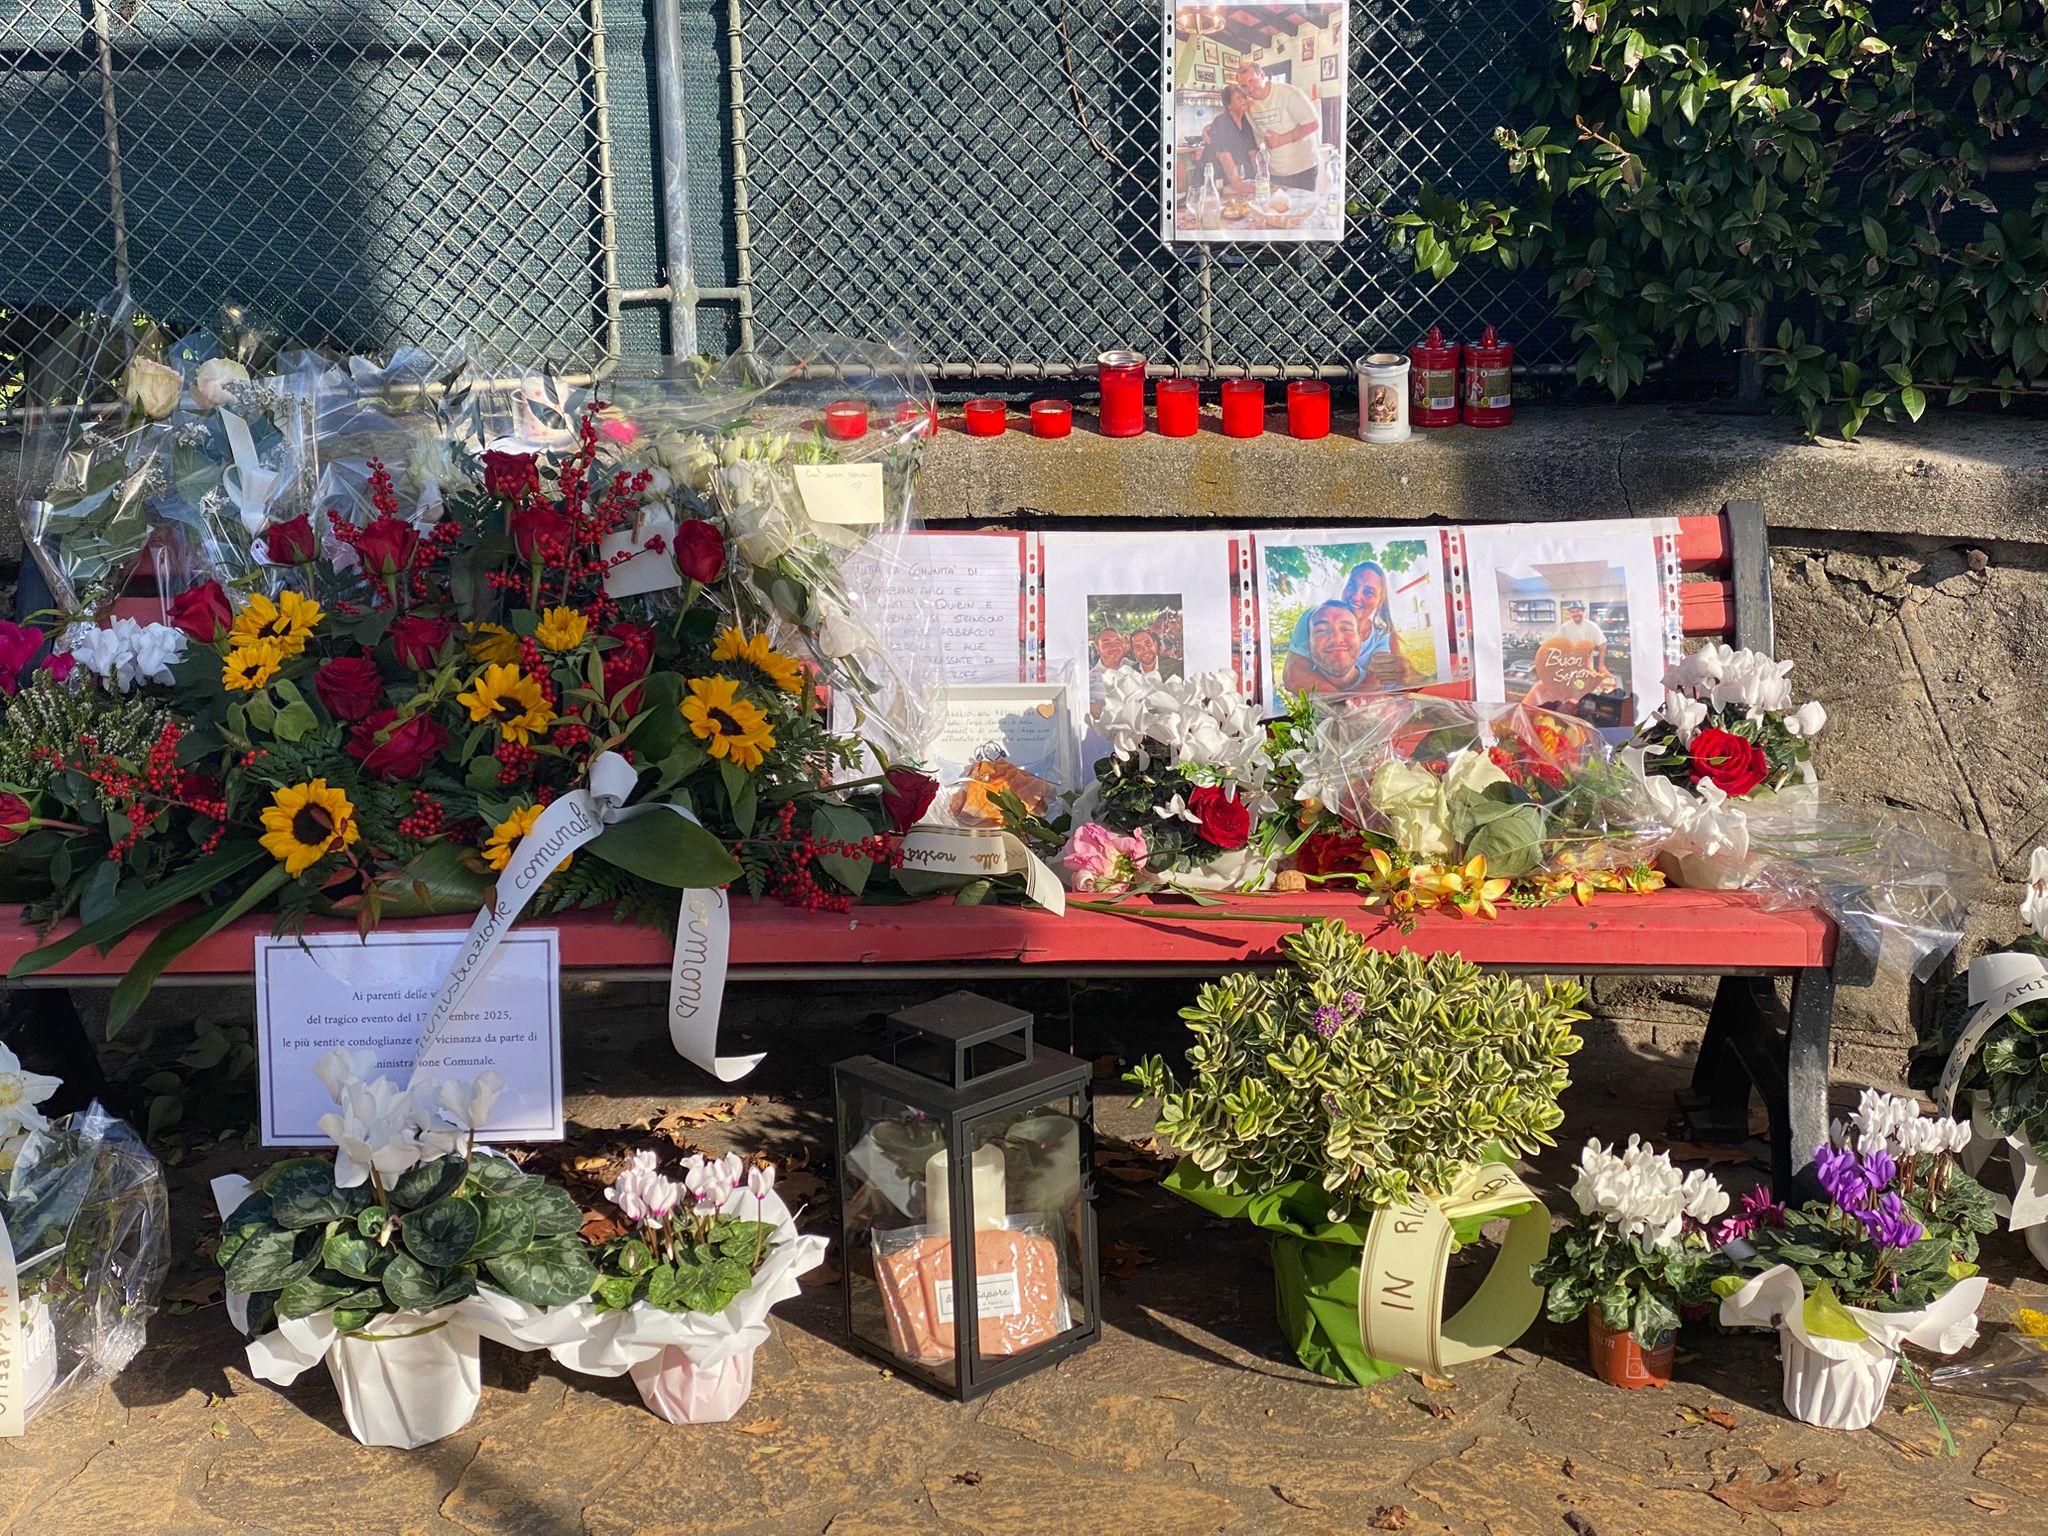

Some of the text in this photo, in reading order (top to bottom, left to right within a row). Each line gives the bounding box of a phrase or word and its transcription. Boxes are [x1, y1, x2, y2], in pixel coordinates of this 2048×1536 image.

[967, 566, 978, 576] DI
[954, 587, 963, 596] E
[986, 601, 992, 609] E
[945, 642, 952, 651] E
[1545, 647, 1583, 668] Buon
[514, 801, 591, 890] comunale
[903, 847, 957, 867] nostra
[970, 852, 1001, 871] alla
[352, 990, 364, 1001] Ai
[366, 990, 401, 1003] parenti
[404, 988, 427, 1000] delle
[306, 1010, 512, 1027] del tragico evento del 17 embre 2025,
[282, 1038, 291, 1048] le
[294, 1038, 310, 1050] più
[348, 1035, 412, 1049] condoglianze
[435, 1033, 482, 1044] vicinanza
[484, 1033, 497, 1043] da
[500, 1033, 525, 1045] parte
[527, 1031, 538, 1042] di
[443, 1055, 496, 1067] Comunale.
[1381, 1270, 1415, 1311] IN
